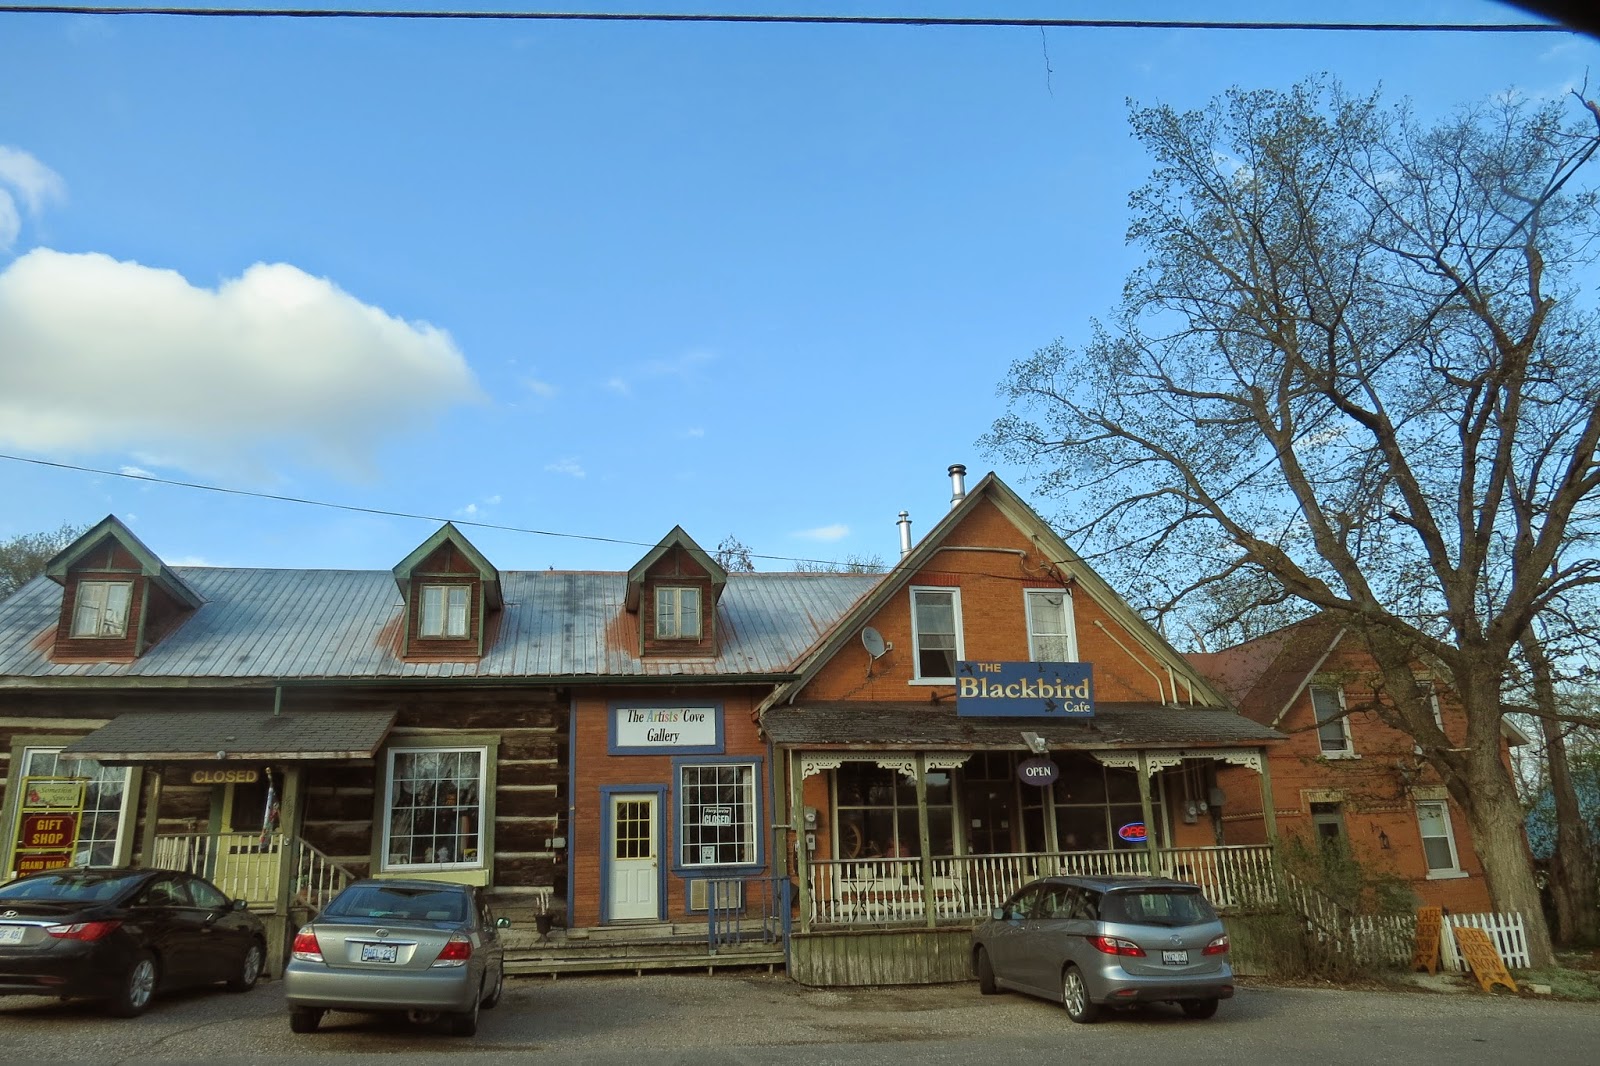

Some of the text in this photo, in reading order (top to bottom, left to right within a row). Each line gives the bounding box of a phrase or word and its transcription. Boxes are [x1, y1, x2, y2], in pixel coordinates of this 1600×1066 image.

[978, 663, 1001, 673] THE
[959, 677, 1089, 699] Blackbird
[1064, 701, 1090, 712] Cafe
[627, 709, 644, 722] The
[683, 709, 704, 722] Cove
[647, 728, 680, 744] Gallery
[192, 770, 258, 783] CLOSED
[1025, 767, 1051, 776] OPEN
[37, 820, 63, 831] GIFT
[704, 815, 730, 825] CLOSED
[1121, 826, 1147, 837] OPE
[32, 833, 64, 844] SHOP
[21, 860, 66, 870] BRAND NAME
[1455, 930, 1490, 942] CAFE
[1463, 944, 1496, 957] OPEN
[1472, 958, 1501, 970] NOW
